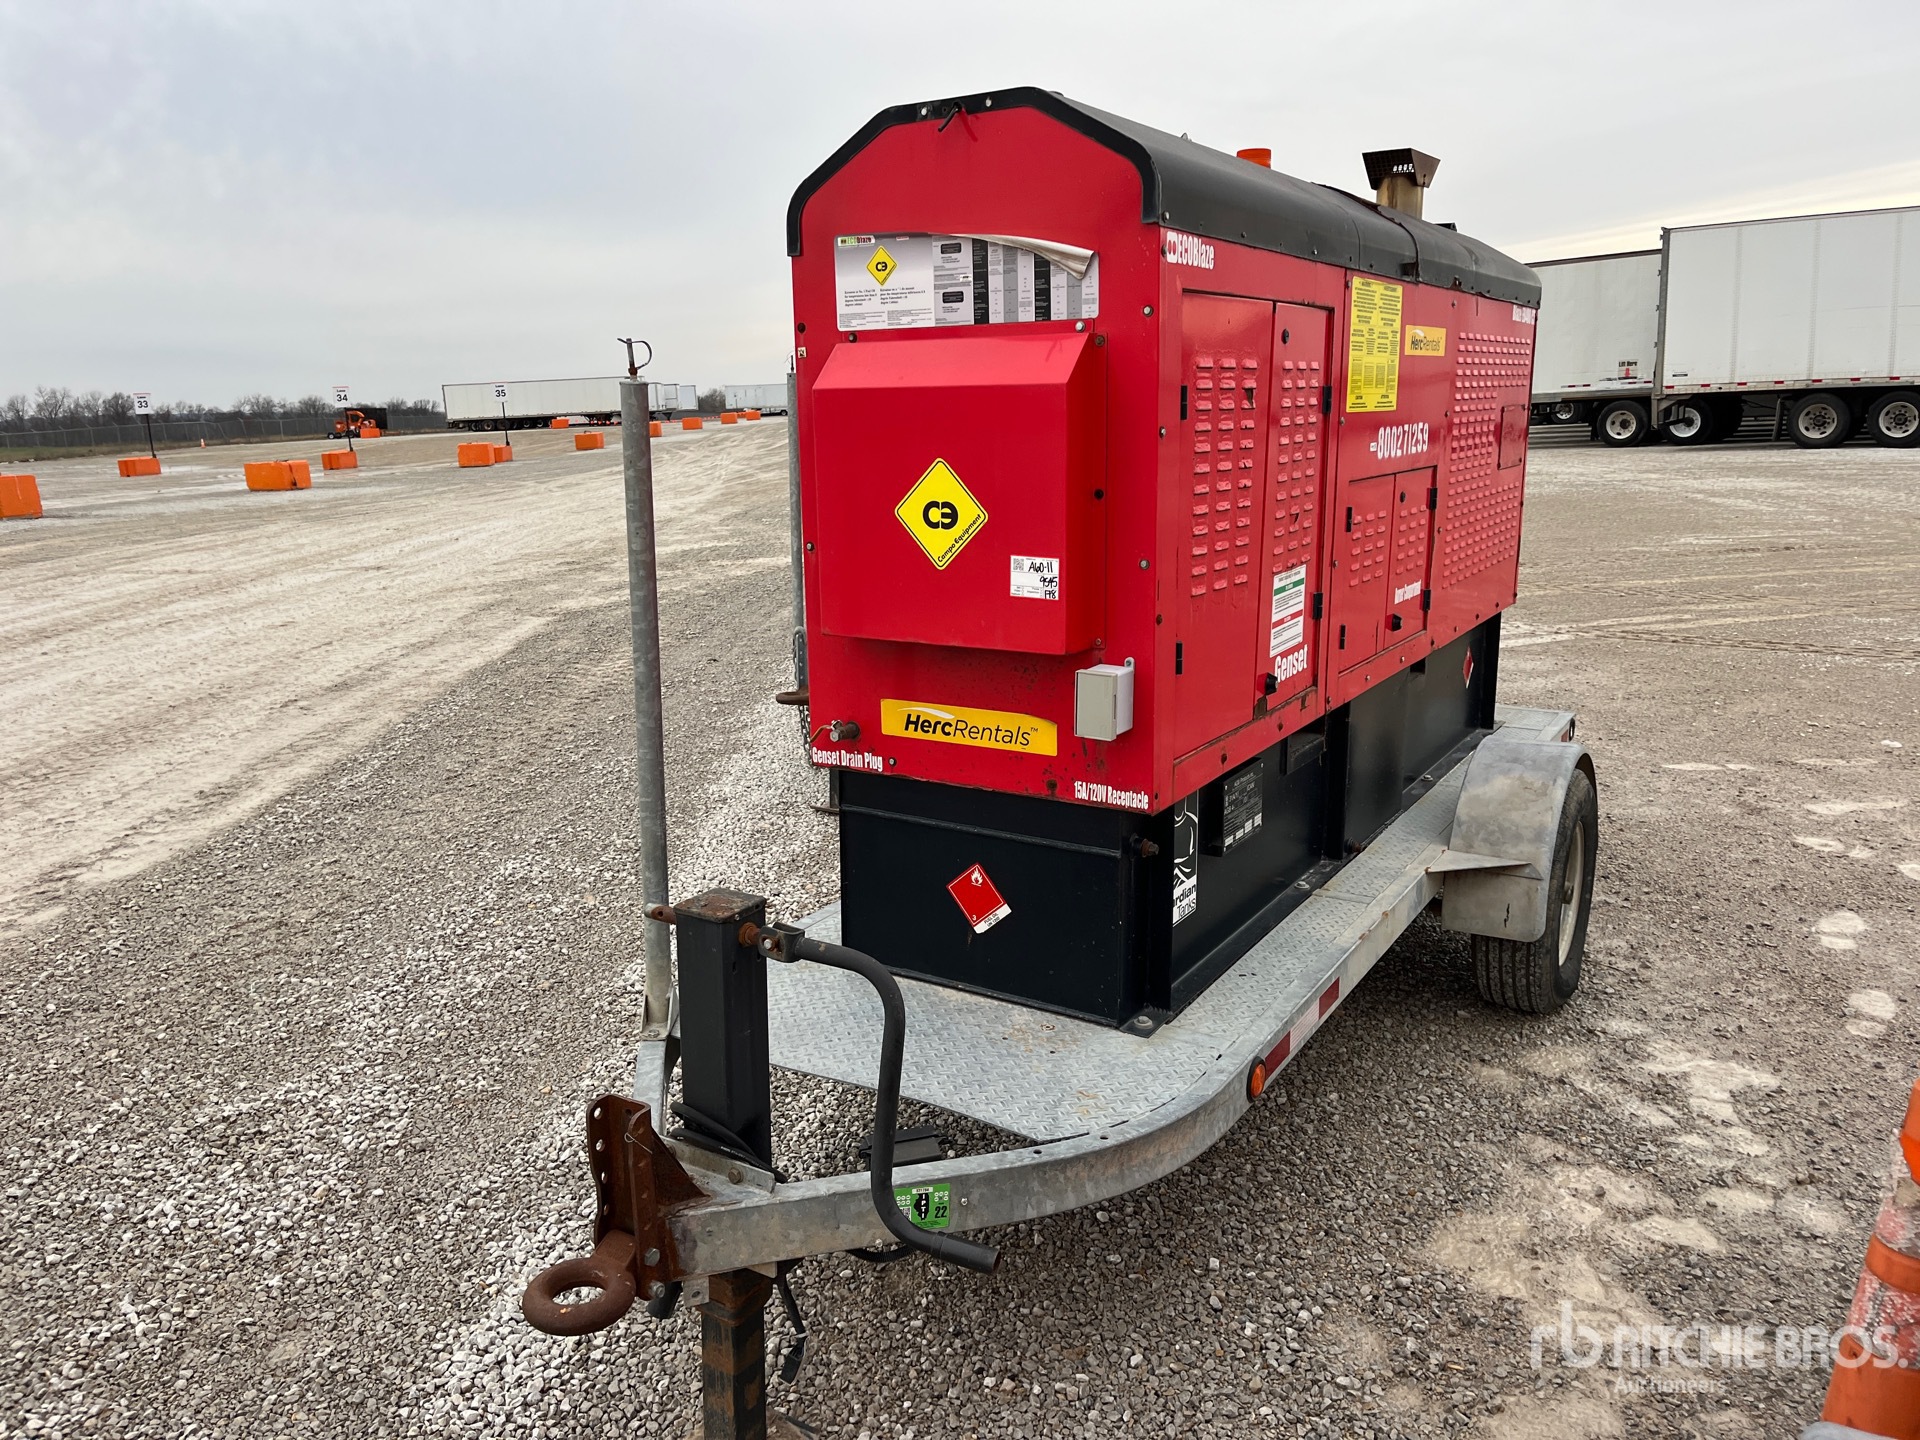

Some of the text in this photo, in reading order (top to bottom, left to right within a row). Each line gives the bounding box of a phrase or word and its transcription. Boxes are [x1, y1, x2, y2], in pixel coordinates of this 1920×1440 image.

[1178, 233, 1215, 270] ECOBlaze
[137, 400, 149, 408] 33
[336, 394, 348, 402] 34
[495, 389, 506, 398] 35
[1377, 422, 1429, 460] 800271259
[937, 513, 982, 563] Campo Equipment
[1274, 644, 1308, 683] Genset
[812, 746, 883, 772] Genset Drain Plug
[1074, 780, 1149, 810] 15A/120V Receptacle
[1173, 884, 1196, 906] rdian
[1177, 897, 1196, 918] Tanks
[934, 1205, 948, 1219] 22
